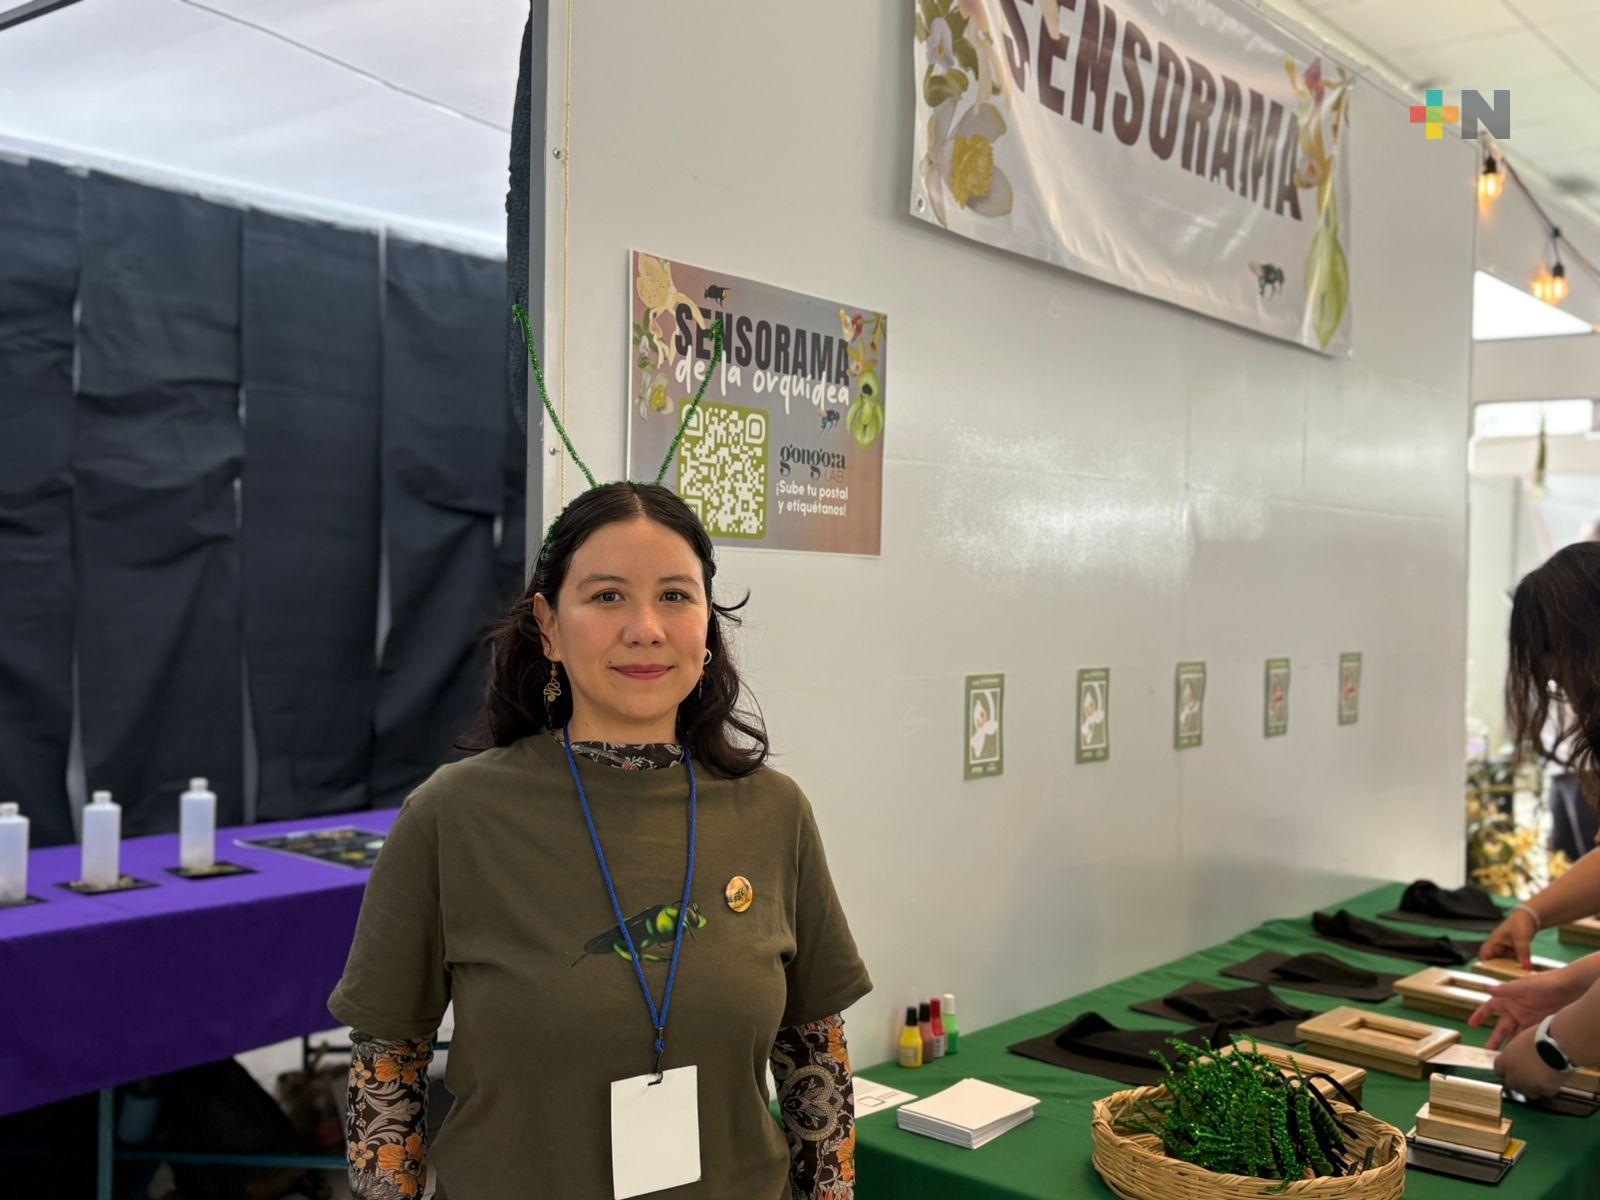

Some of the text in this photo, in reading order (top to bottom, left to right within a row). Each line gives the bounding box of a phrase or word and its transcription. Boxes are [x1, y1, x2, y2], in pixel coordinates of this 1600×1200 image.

[999, 0, 1303, 222] SENSORAMA
[674, 302, 850, 387] SENSORAMA
[675, 344, 850, 415] de la orquídea
[777, 500, 784, 515] y
[807, 483, 817, 496] tu
[819, 486, 849, 501] postal
